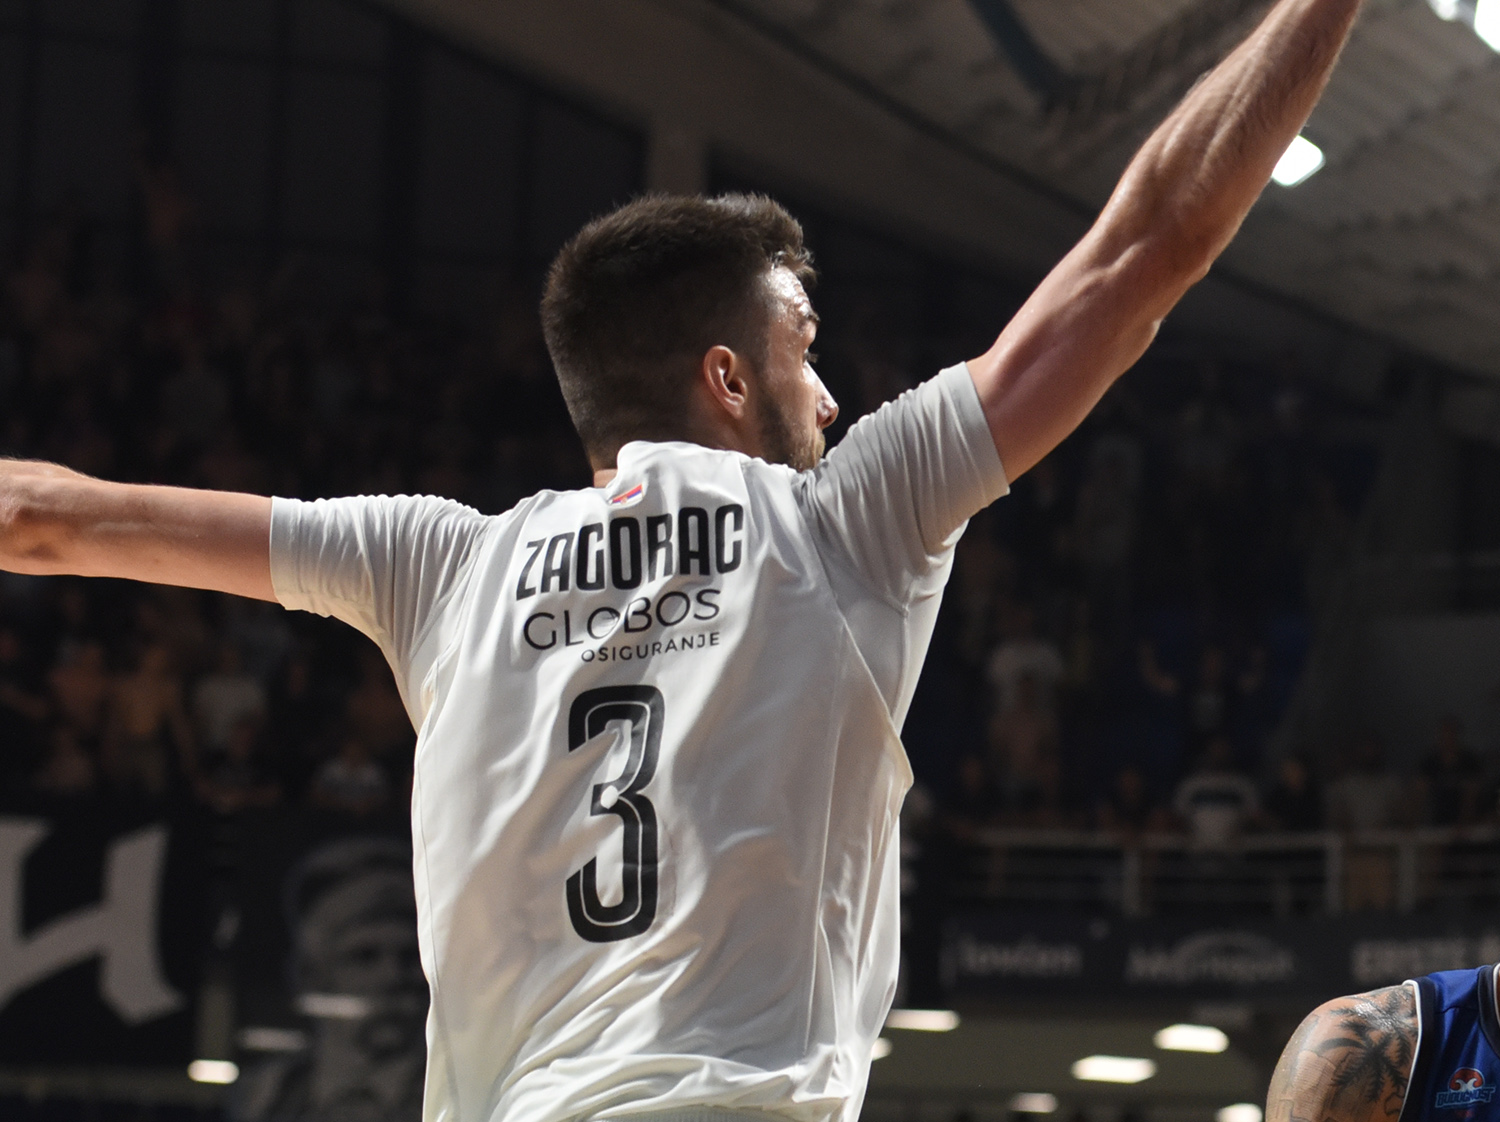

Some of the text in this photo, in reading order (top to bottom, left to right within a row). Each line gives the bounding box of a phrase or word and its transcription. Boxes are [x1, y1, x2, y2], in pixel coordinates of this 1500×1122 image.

[516, 503, 744, 601] ZAGORAC
[523, 588, 722, 651] GLOBOS
[581, 631, 721, 663] OSIGURANJE
[566, 684, 666, 943] 3
